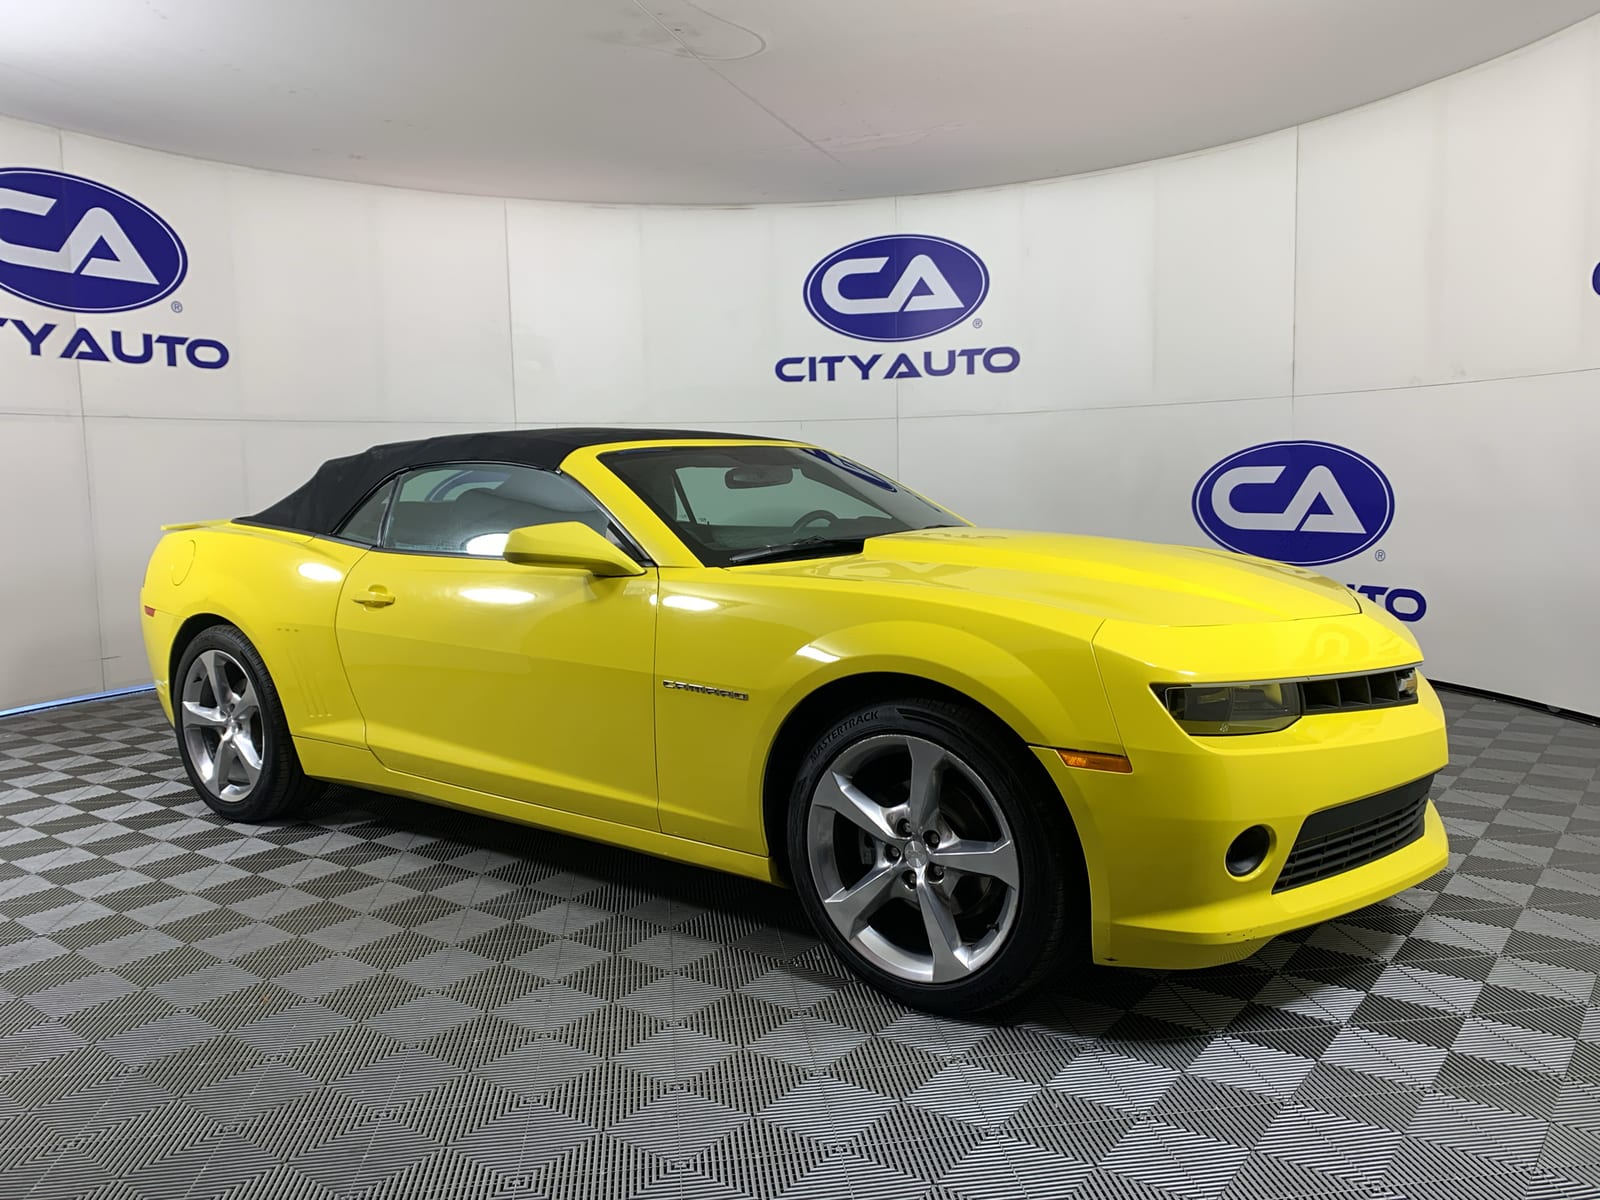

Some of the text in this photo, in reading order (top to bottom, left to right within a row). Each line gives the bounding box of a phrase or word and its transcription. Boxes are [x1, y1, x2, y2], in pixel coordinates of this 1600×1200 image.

[821, 254, 965, 315] CA
[1211, 465, 1367, 535] CA
[808, 710, 880, 764] MASTERTRACK
